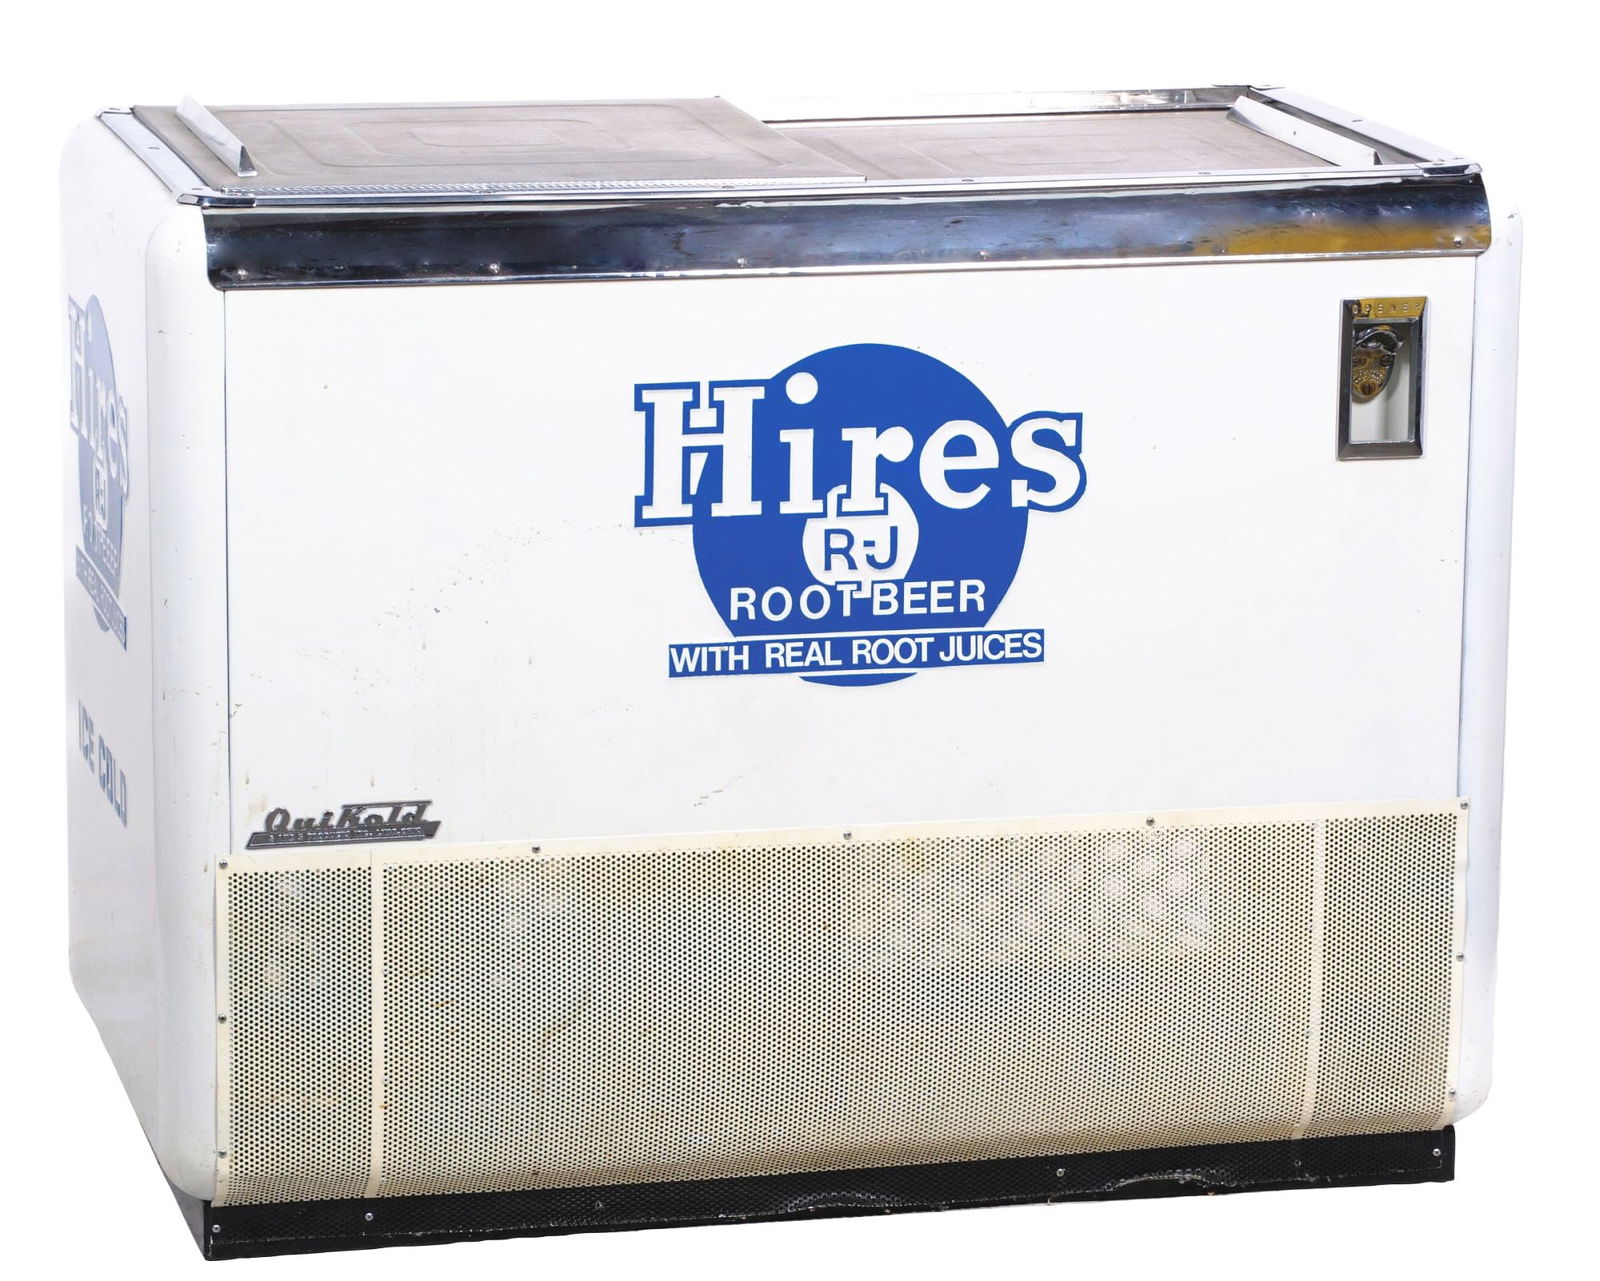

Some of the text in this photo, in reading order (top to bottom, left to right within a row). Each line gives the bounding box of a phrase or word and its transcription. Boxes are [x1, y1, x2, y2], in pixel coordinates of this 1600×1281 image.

[642, 372, 1081, 519] Hires
[824, 526, 898, 571] R-J
[730, 579, 985, 621] ROOT BEER
[670, 632, 1042, 673] WITH REAL ROOT JUICES
[79, 699, 127, 828] ICE COLD
